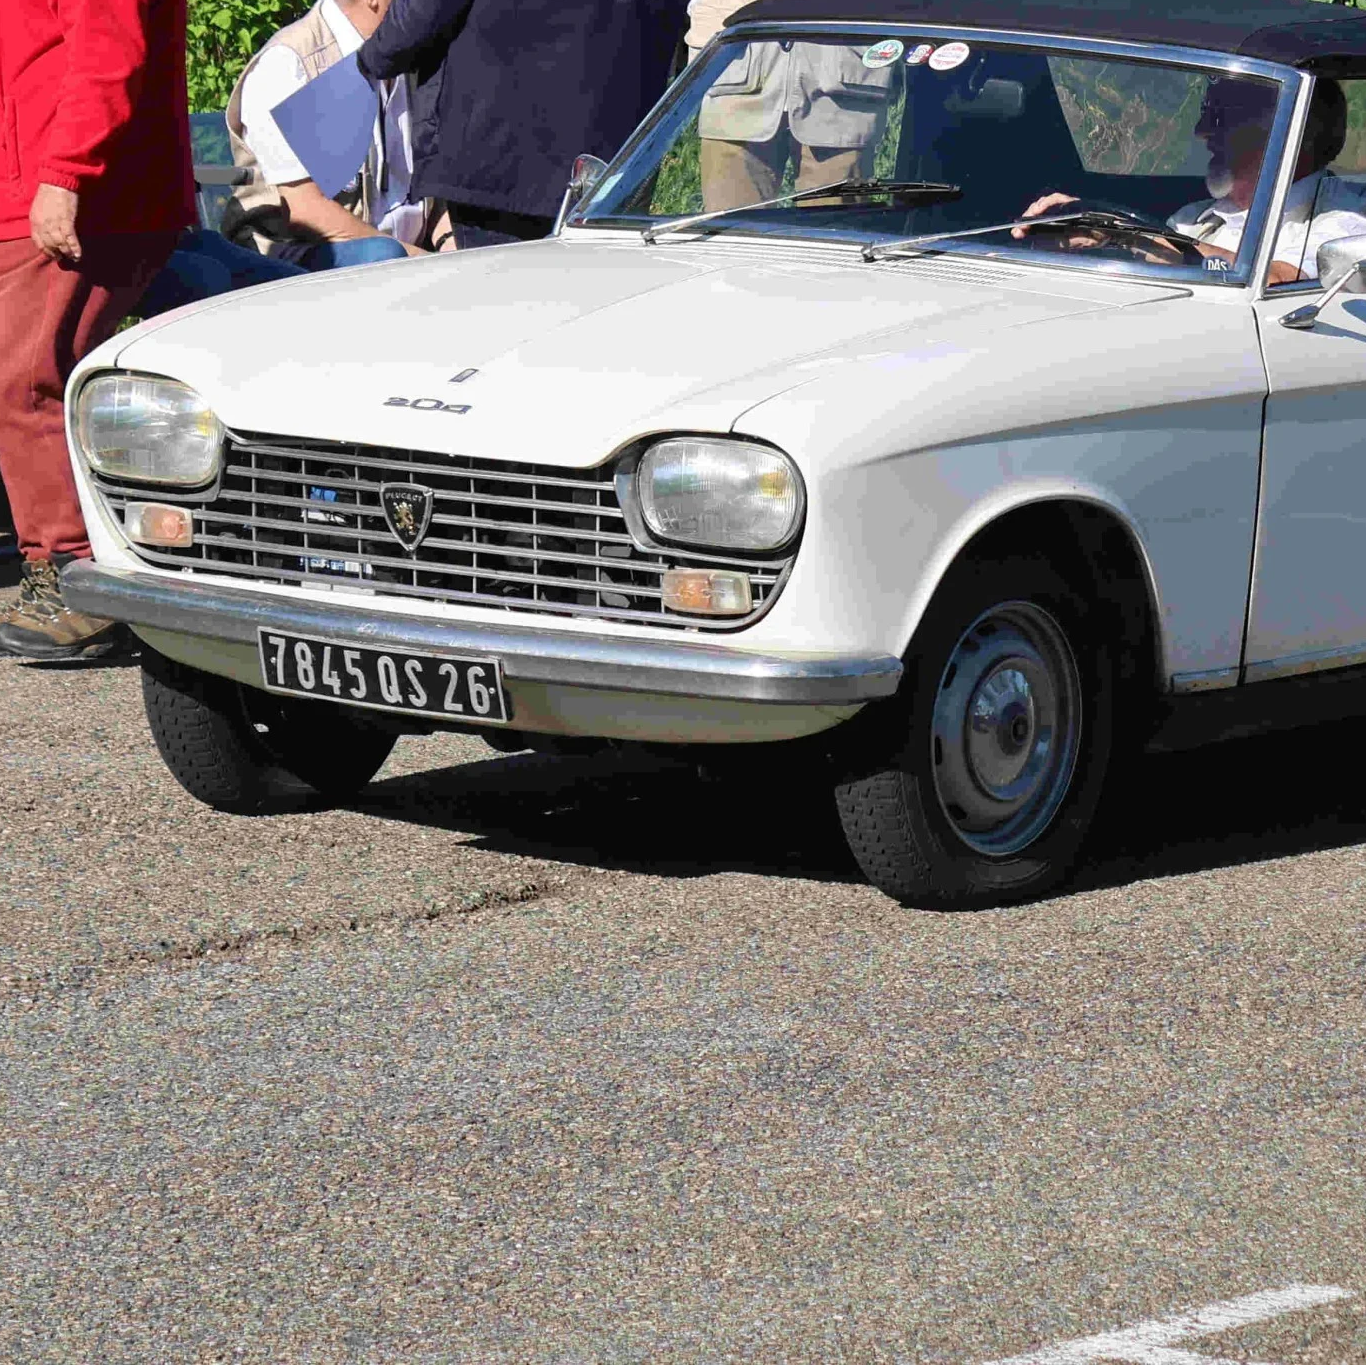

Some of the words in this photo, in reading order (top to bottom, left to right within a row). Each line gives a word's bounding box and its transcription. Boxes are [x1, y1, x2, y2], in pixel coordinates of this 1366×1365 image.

[382, 397, 473, 415] 204
[268, 636, 367, 699] 7845
[377, 655, 428, 708] QS
[438, 663, 491, 715] 26
